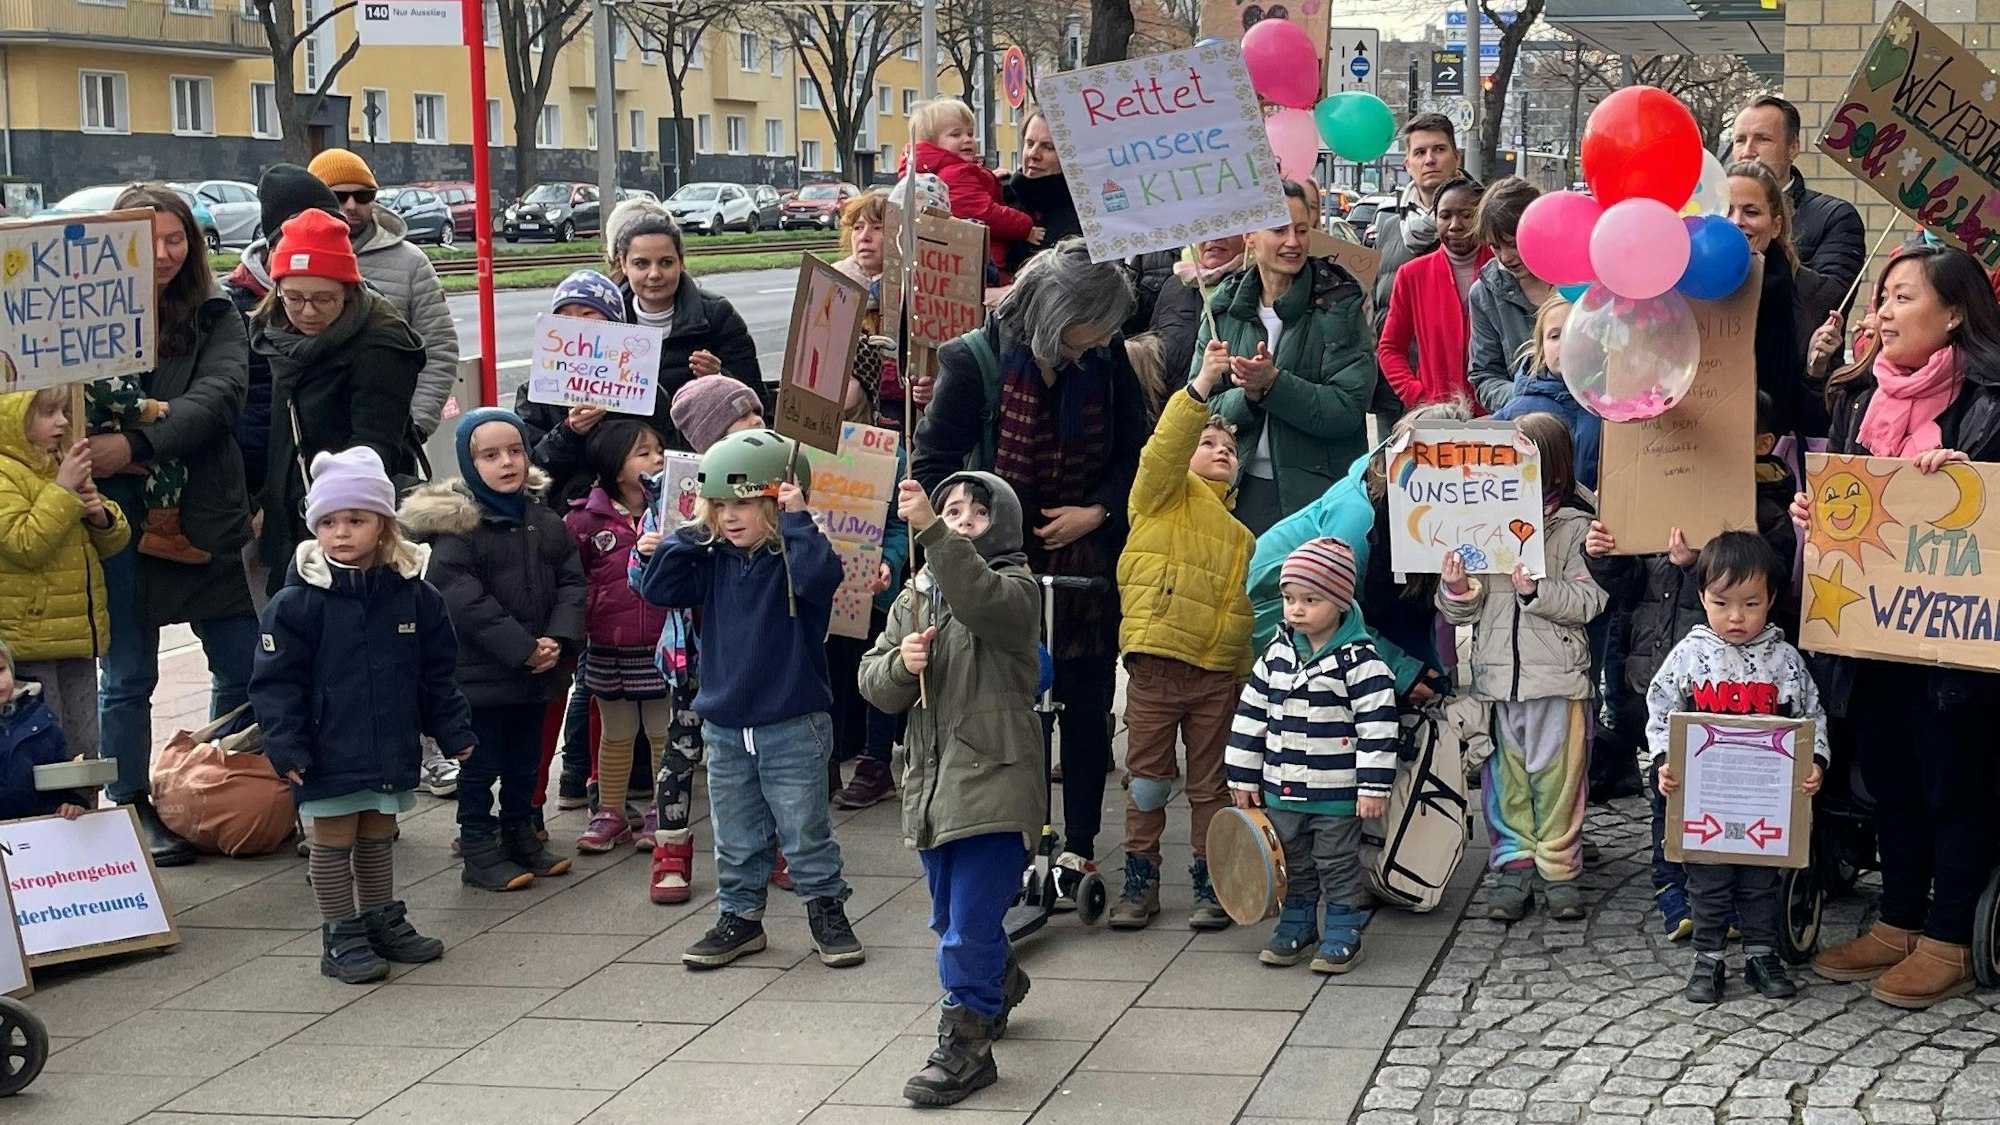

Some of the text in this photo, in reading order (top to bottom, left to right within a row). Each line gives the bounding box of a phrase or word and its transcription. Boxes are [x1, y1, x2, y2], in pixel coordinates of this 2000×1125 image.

[366, 6, 446, 19] 140 Nur Ausstieg
[1081, 67, 1215, 126] Rettet
[1893, 31, 2000, 179] WEYERTA
[1108, 128, 1230, 167] unsere
[1825, 102, 1907, 179] Soll
[1138, 153, 1260, 206] KITA!
[919, 248, 964, 276] ICHT
[4, 276, 145, 326] WEYERTAL
[914, 295, 975, 328] EINEM
[21, 317, 143, 368] 4-EVER!
[542, 359, 649, 386] unsere Kita
[566, 377, 645, 400] NICHT!!!
[863, 430, 895, 453] Die
[1409, 479, 1519, 505] UNSERE
[1428, 520, 1504, 547] KITA
[11, 860, 138, 892] strophengebiet
[18, 892, 149, 927] derbetreuung
